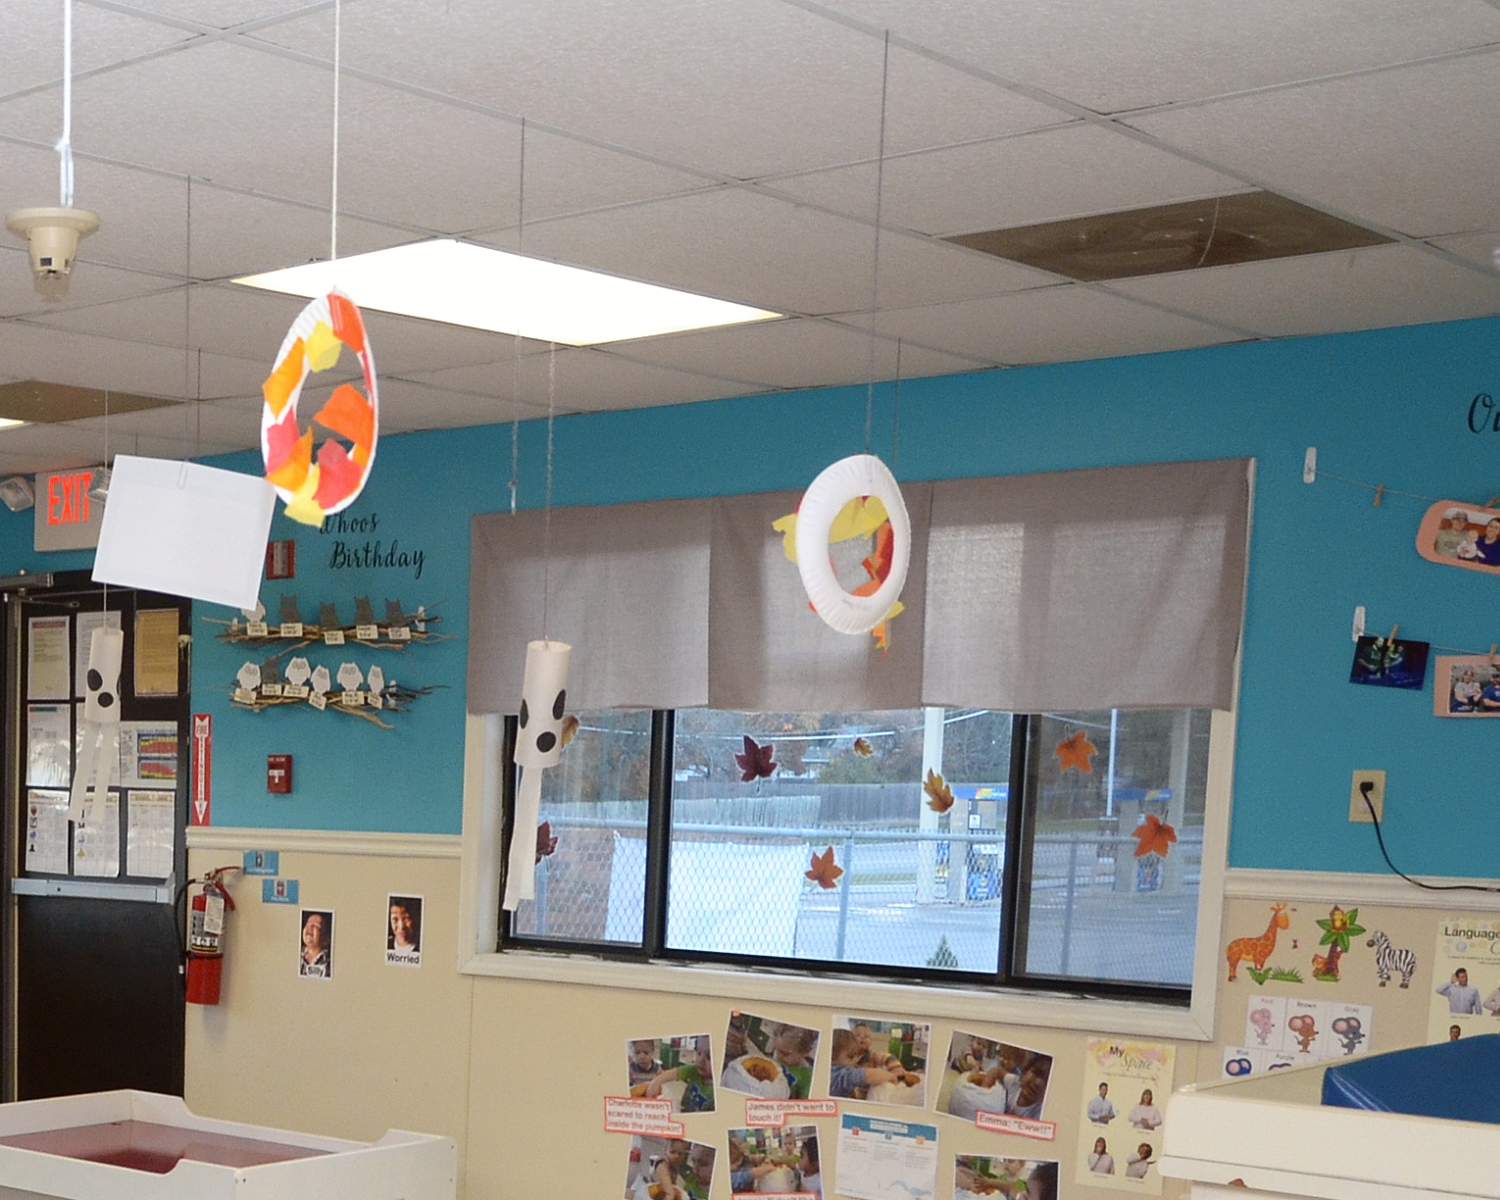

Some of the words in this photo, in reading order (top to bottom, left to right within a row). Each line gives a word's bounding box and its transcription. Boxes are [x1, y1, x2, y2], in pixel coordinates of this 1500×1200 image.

[47, 472, 93, 525] EXIT
[329, 539, 426, 580] Birthday
[387, 953, 420, 964] Worried
[307, 966, 324, 978] Silly
[1110, 1046, 1124, 1058] My
[748, 1103, 774, 1111] James
[803, 1104, 824, 1112] want
[826, 1104, 834, 1112] to
[608, 1110, 634, 1118] scared
[635, 1112, 644, 1120] to
[645, 1112, 666, 1120] reach
[608, 1120, 630, 1128] inside
[632, 1121, 644, 1130] the
